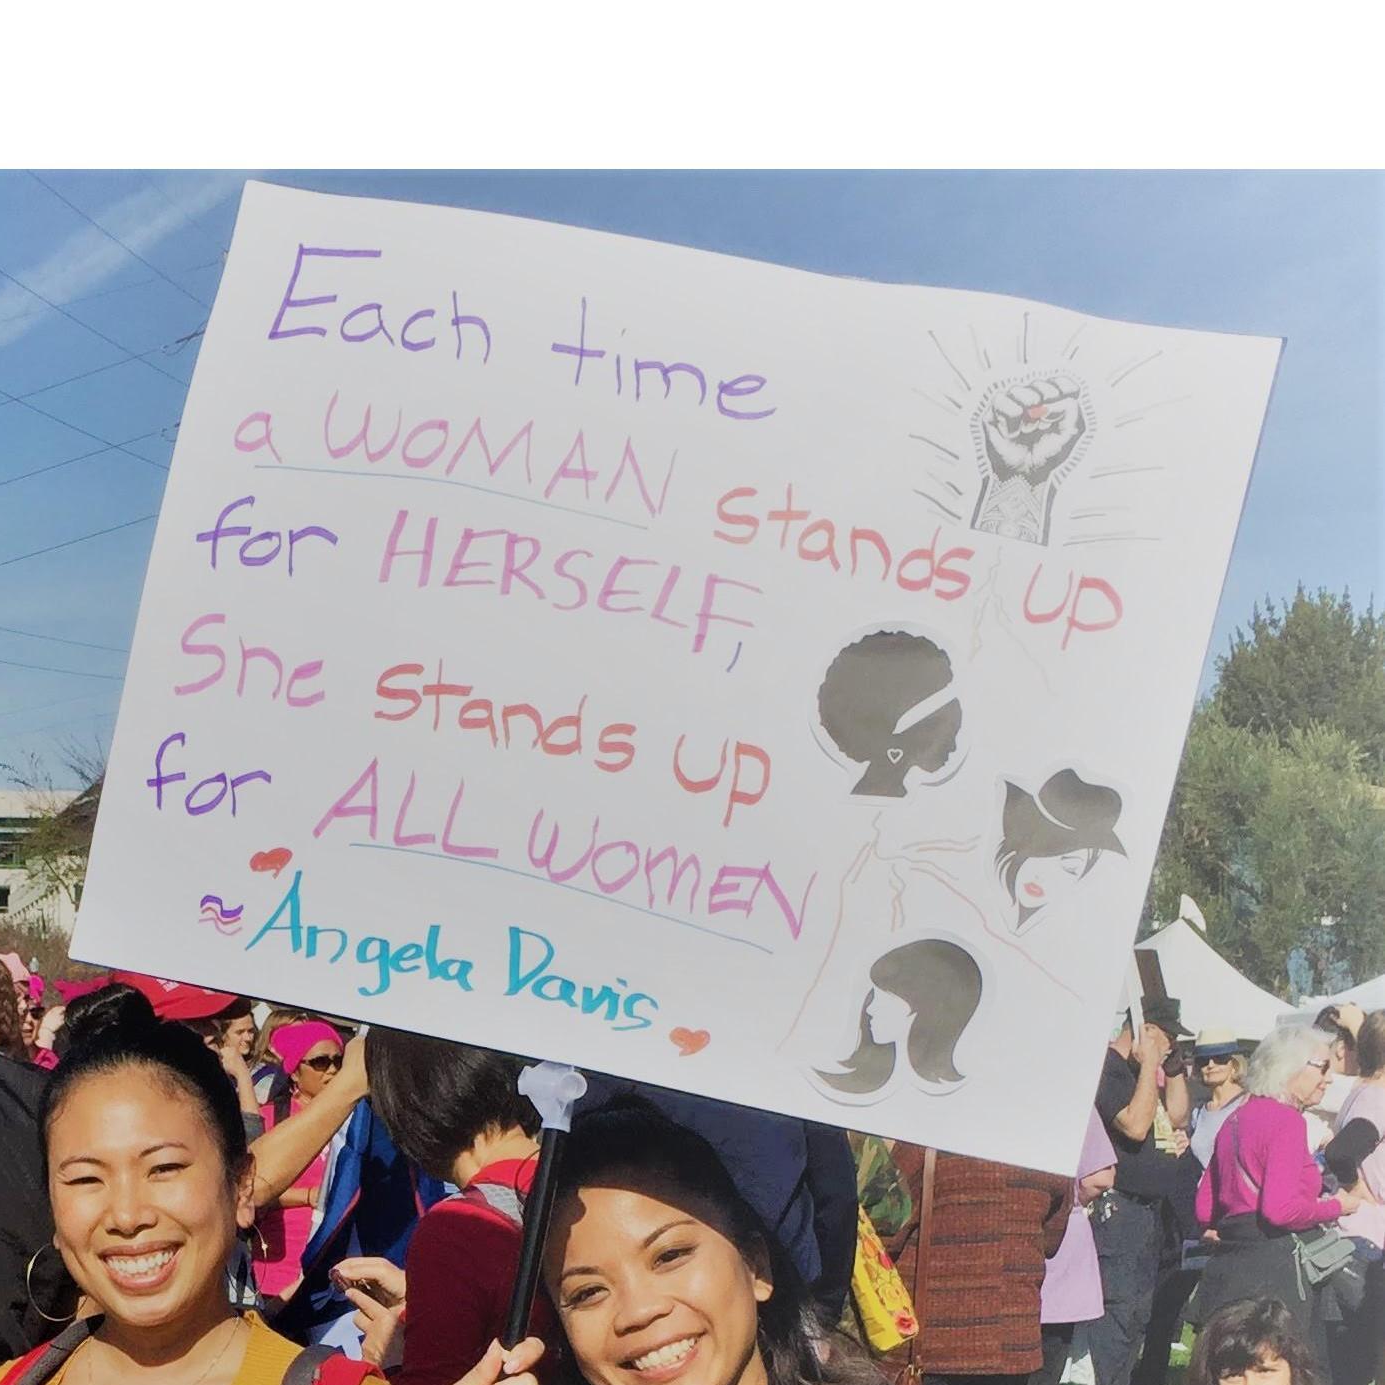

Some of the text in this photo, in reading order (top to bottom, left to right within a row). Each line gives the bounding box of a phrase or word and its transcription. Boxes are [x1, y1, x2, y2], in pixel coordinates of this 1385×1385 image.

[268, 242, 777, 420] Each time
[233, 411, 284, 464] a
[323, 388, 680, 519] WOMAN
[713, 482, 976, 601] stands
[195, 495, 765, 673] for HERSELF,
[373, 657, 638, 774] stands
[145, 731, 817, 940] for ALL WOMEN
[244, 869, 660, 1032] Angela Davis
